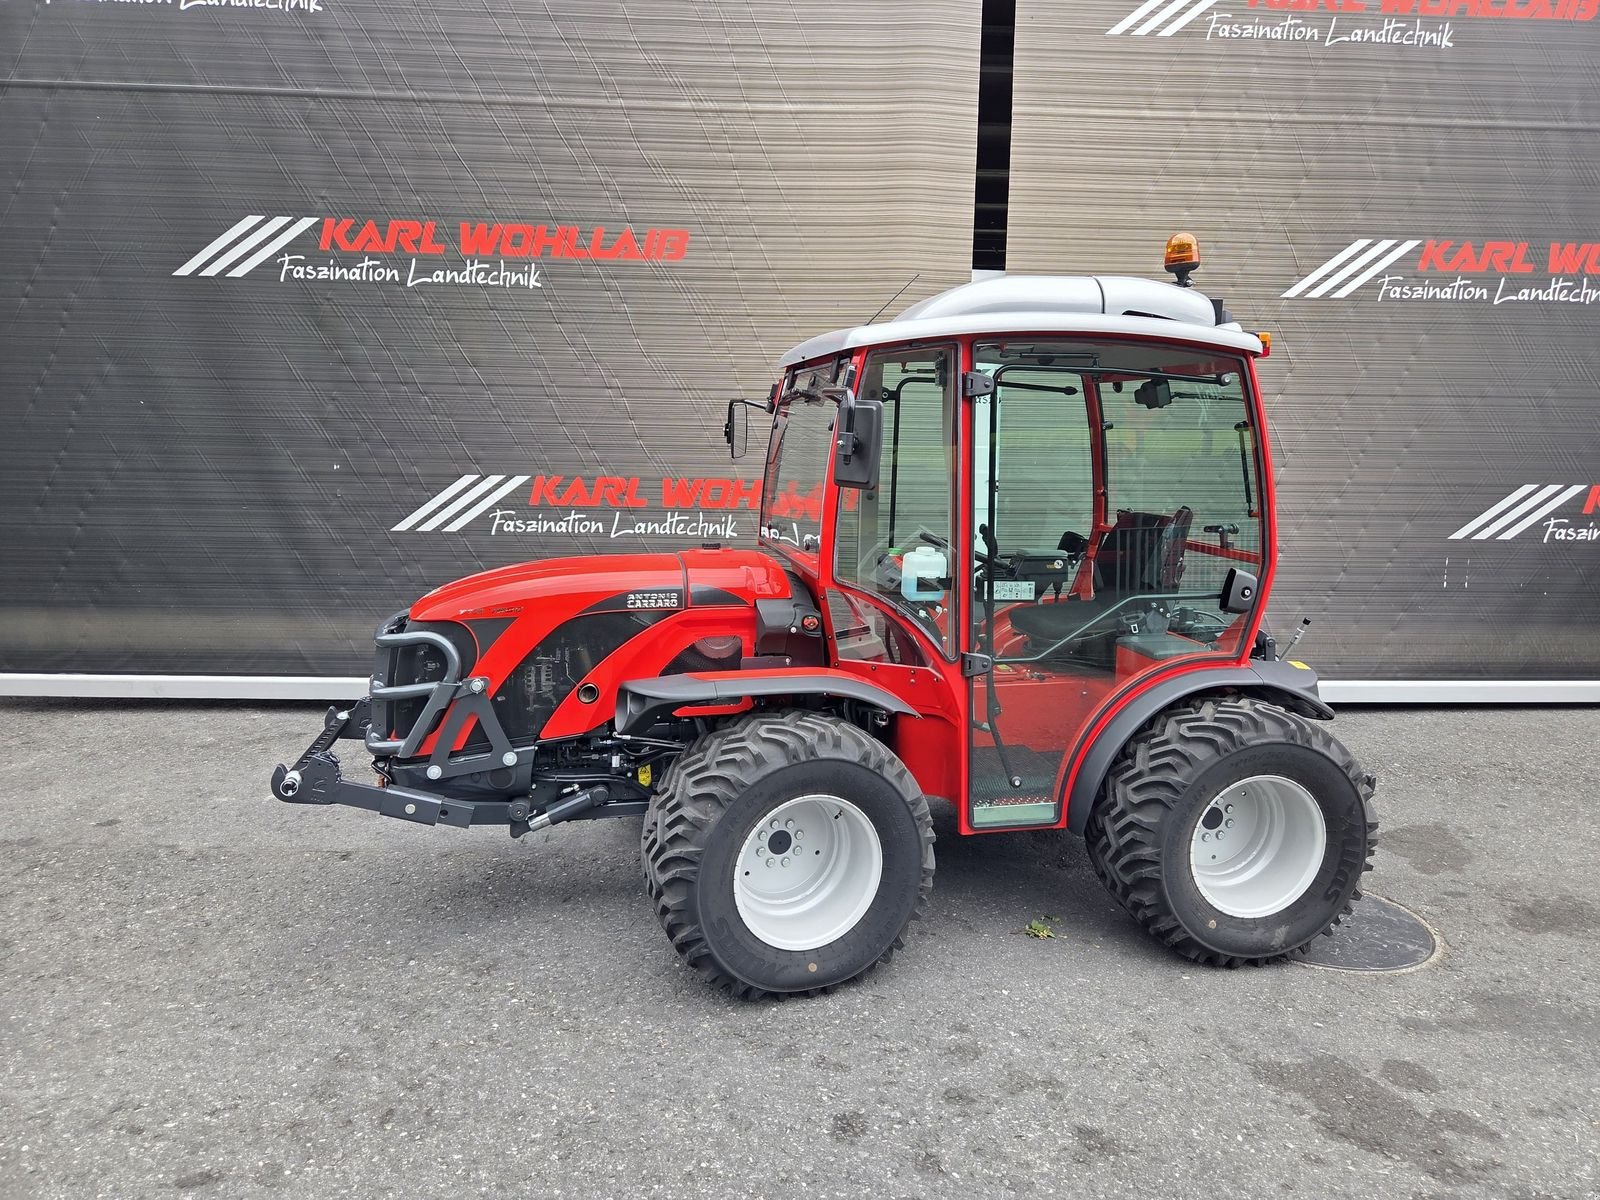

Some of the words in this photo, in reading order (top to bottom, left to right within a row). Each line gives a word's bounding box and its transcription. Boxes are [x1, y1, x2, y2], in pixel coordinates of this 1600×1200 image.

[1206, 10, 1319, 43] Faszination
[1325, 16, 1454, 49] Landtechnik
[319, 217, 446, 255] KARL
[276, 253, 400, 282] Faszination
[406, 257, 542, 289] Landtechnik
[1417, 239, 1534, 273] KARL
[1376, 274, 1488, 302] Faszination
[528, 475, 648, 508] KARL
[488, 508, 604, 536] Faszination
[610, 511, 738, 539] Landtechnik
[626, 599, 678, 609] CARRARO
[627, 592, 678, 600] ANTONIO
